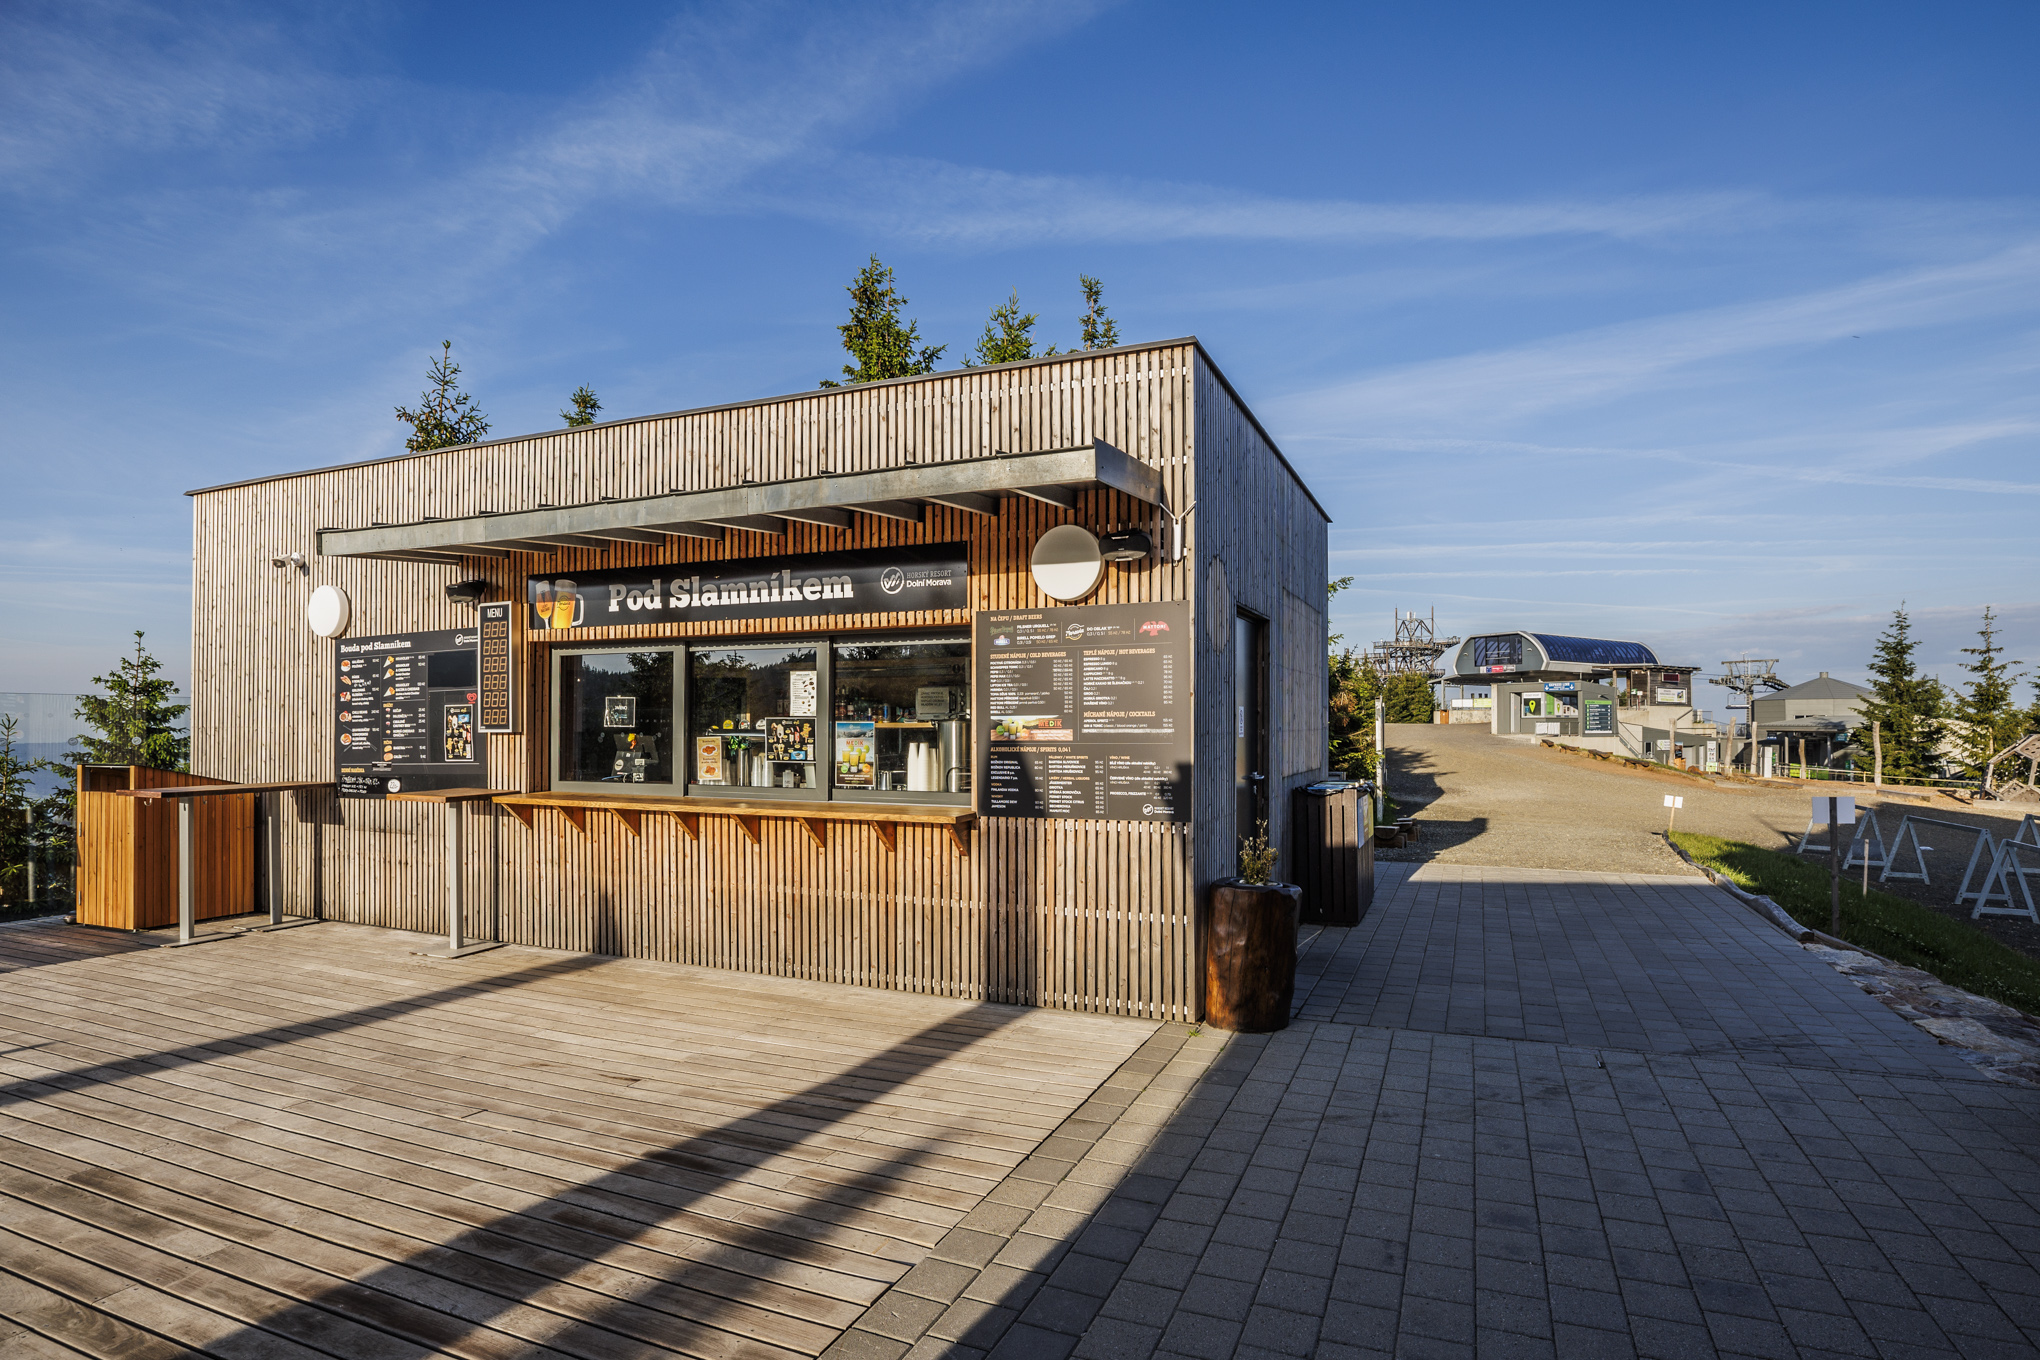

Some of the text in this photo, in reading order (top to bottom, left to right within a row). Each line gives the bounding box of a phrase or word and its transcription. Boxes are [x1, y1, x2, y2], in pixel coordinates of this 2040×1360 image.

[907, 570, 928, 578] HORSKÝ
[907, 579, 925, 587] Dolní
[608, 570, 854, 612] Pod Slamníkem
[487, 608, 502, 618] MENU
[340, 643, 360, 653] Bouda
[361, 642, 373, 653] pod
